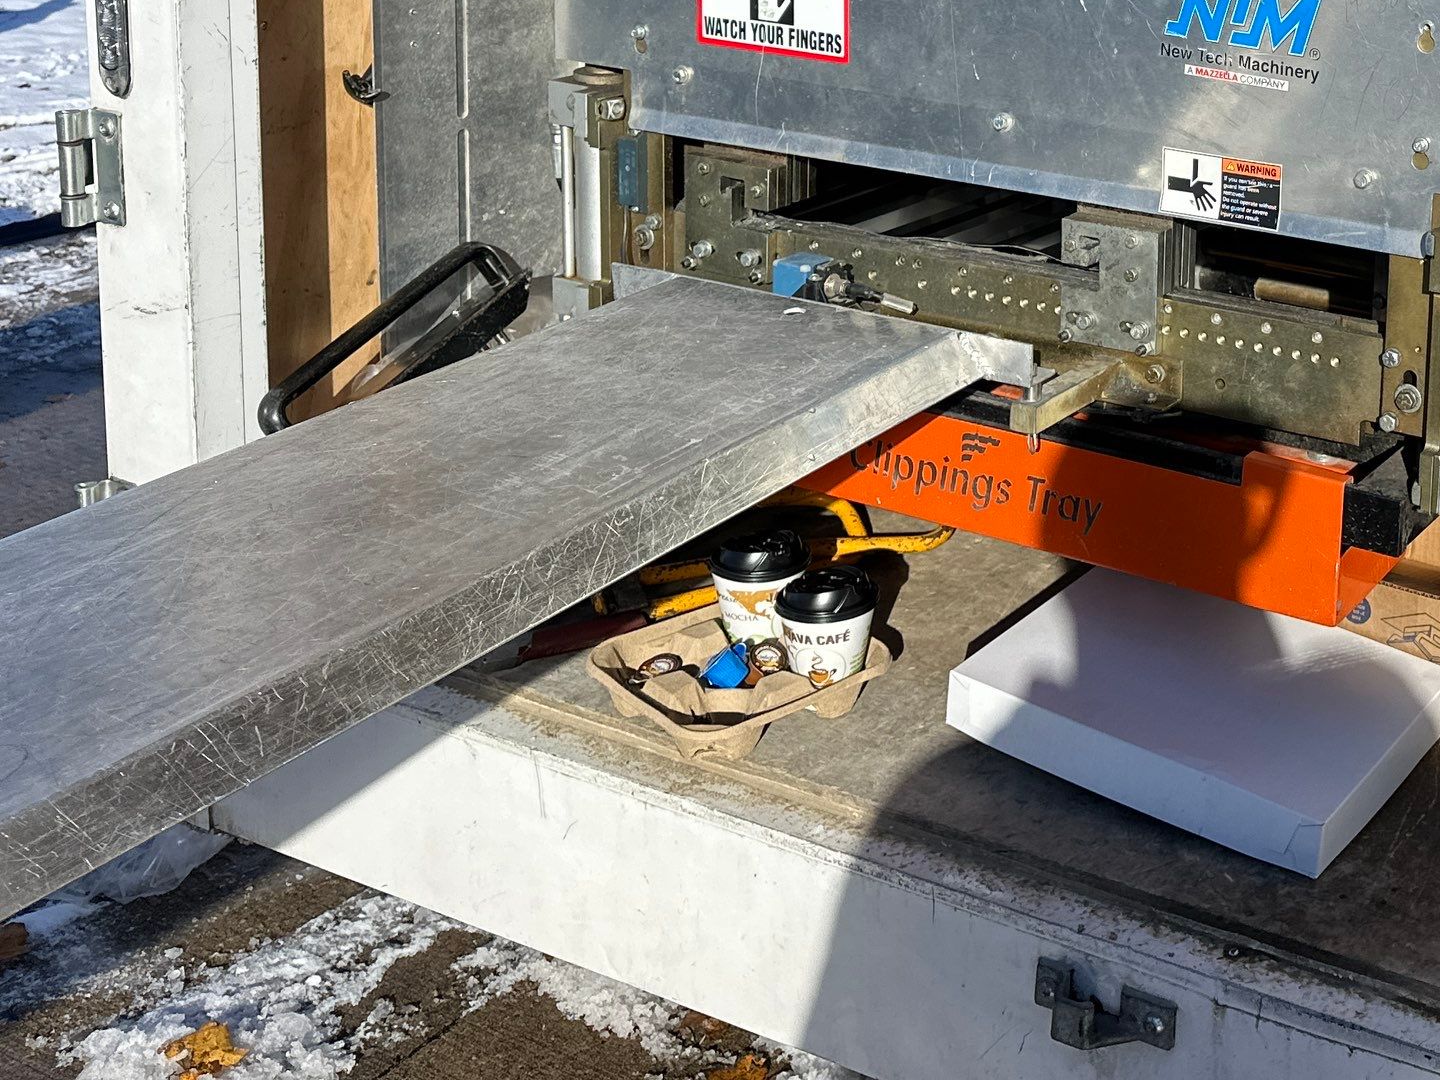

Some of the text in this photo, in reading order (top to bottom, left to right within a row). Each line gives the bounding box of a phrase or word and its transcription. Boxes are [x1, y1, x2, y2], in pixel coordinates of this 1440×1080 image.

[704, 16, 842, 55] WATCH YOUR FINGERS
[1161, 43, 1319, 84] New Tech Machinery
[1187, 66, 1285, 89] A MAZZELLA COMPANY
[1236, 163, 1277, 177] WARNING
[1239, 199, 1259, 207] operate
[850, 440, 1102, 535] Clippings Tray
[725, 611, 759, 622] MOCHA
[816, 628, 850, 646] CAFÉ
